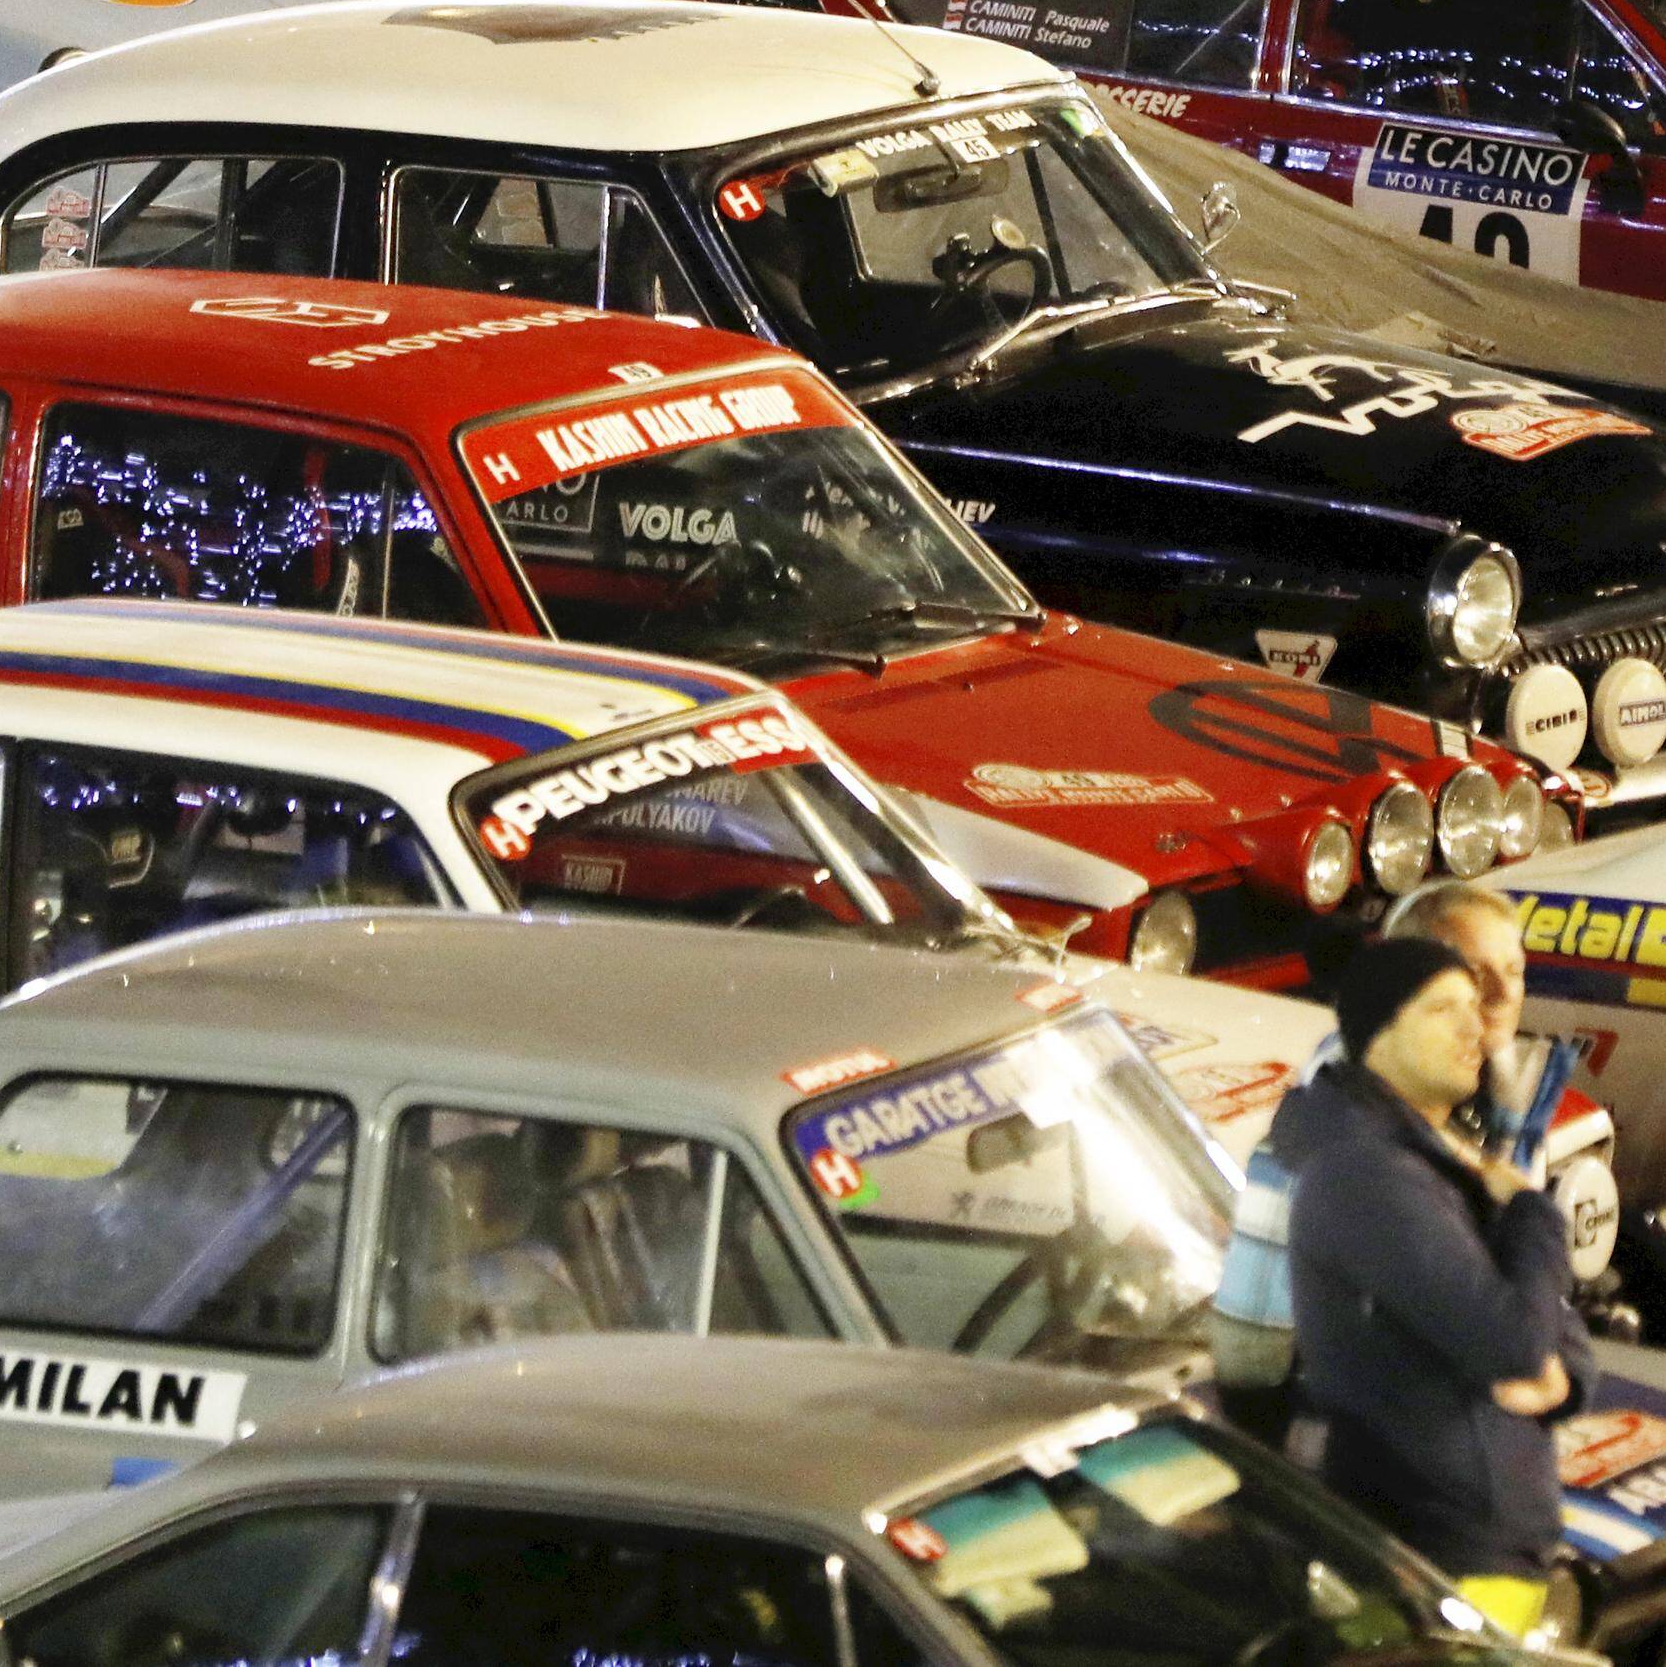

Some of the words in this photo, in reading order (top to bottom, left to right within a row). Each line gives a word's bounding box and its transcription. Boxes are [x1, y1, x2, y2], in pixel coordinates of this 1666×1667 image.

[964, 16, 1033, 40] CAMINITI
[1034, 23, 1092, 50] Stefano
[1044, 7, 1110, 34] Pasquale
[1379, 125, 1418, 164] LE
[1427, 133, 1576, 188] CASINO
[722, 184, 764, 220] H
[1385, 171, 1466, 200] MONTE
[1478, 181, 1553, 211] CARLO
[308, 310, 613, 370] STROYHOUSE
[482, 452, 521, 485] H
[644, 396, 725, 448] RACING
[727, 385, 800, 433] GROUP
[506, 500, 571, 524] ARLO
[619, 501, 737, 545] VOLGA
[484, 822, 527, 860] H
[510, 732, 707, 841] PEUGEOT
[1514, 892, 1645, 968] etal
[814, 1151, 860, 1198] H
